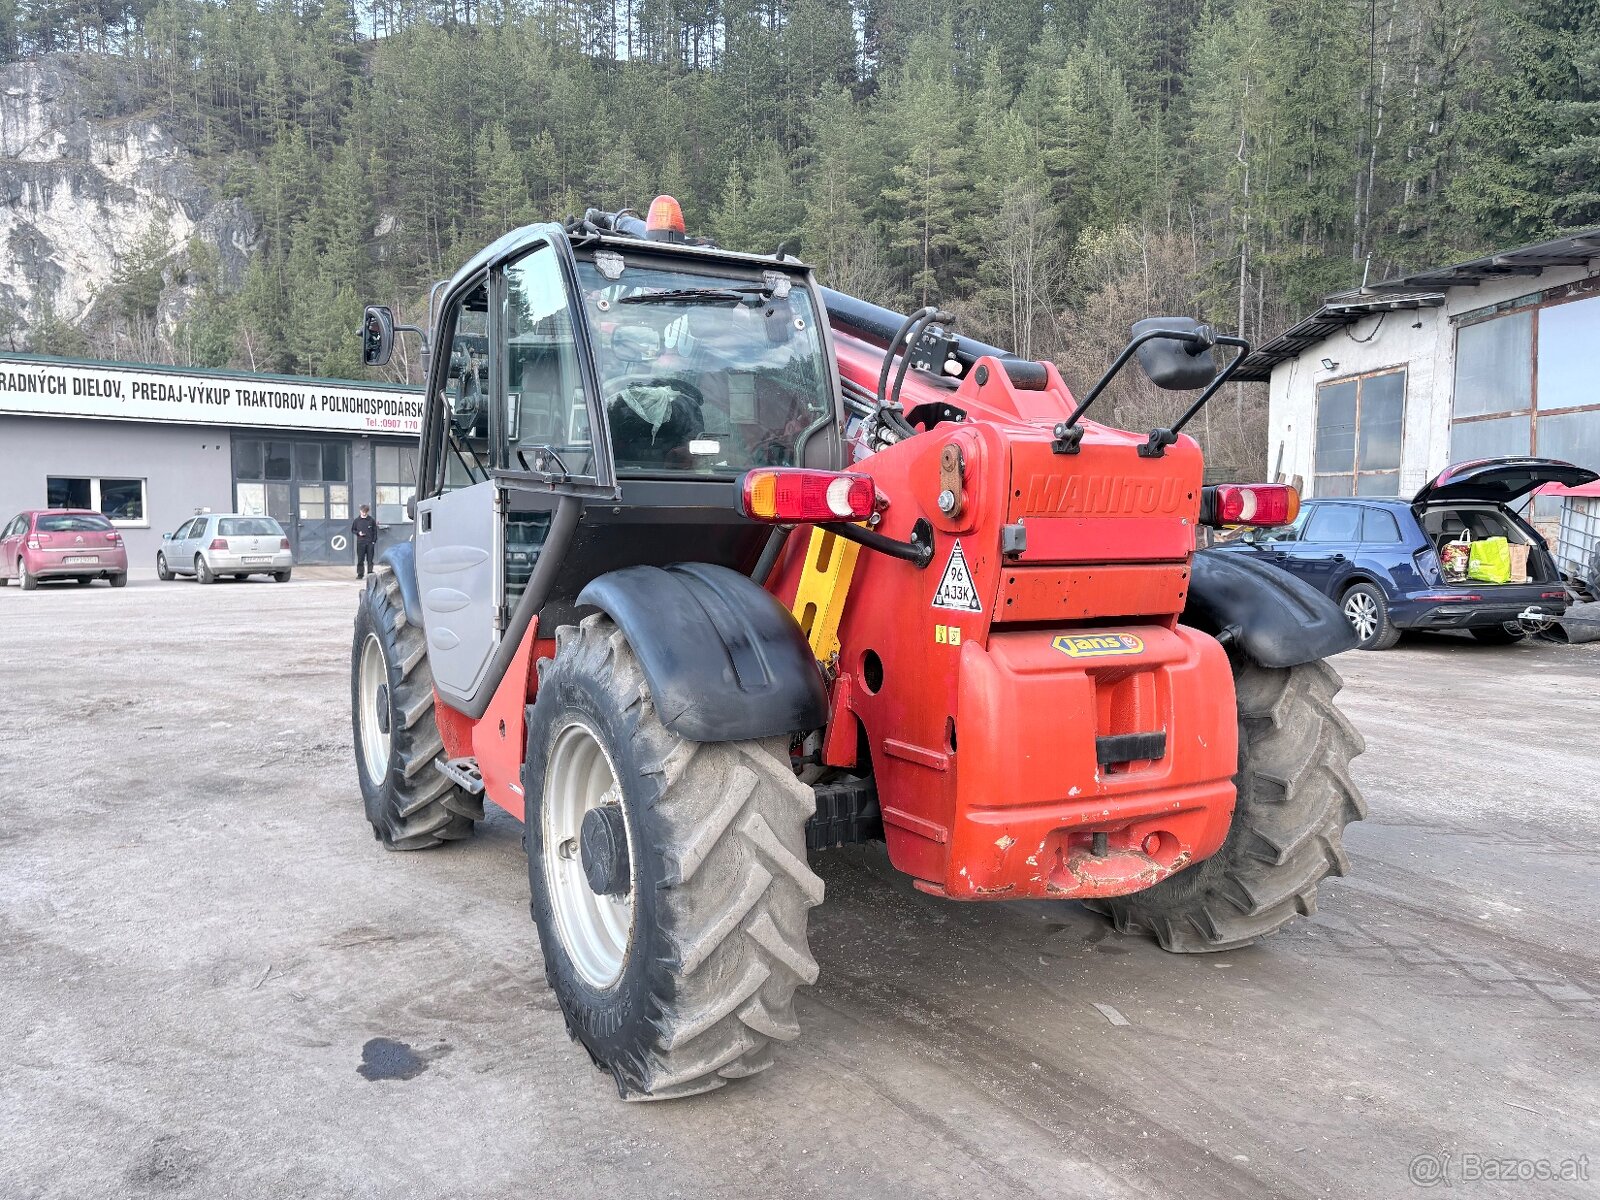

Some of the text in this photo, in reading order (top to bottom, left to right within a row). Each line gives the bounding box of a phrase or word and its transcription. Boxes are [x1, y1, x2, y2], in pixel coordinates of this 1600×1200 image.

[0, 369, 67, 395] RADNÝCH
[73, 376, 126, 402] DIELOV,
[132, 381, 231, 406] PREDAJ-VÝKUP
[235, 389, 305, 410] TRAKTOROV
[309, 394, 318, 411] A
[404, 420, 418, 430] 170
[1025, 473, 1185, 514] MANITOU
[951, 567, 963, 582] 96
[1063, 636, 1122, 654] Jans
